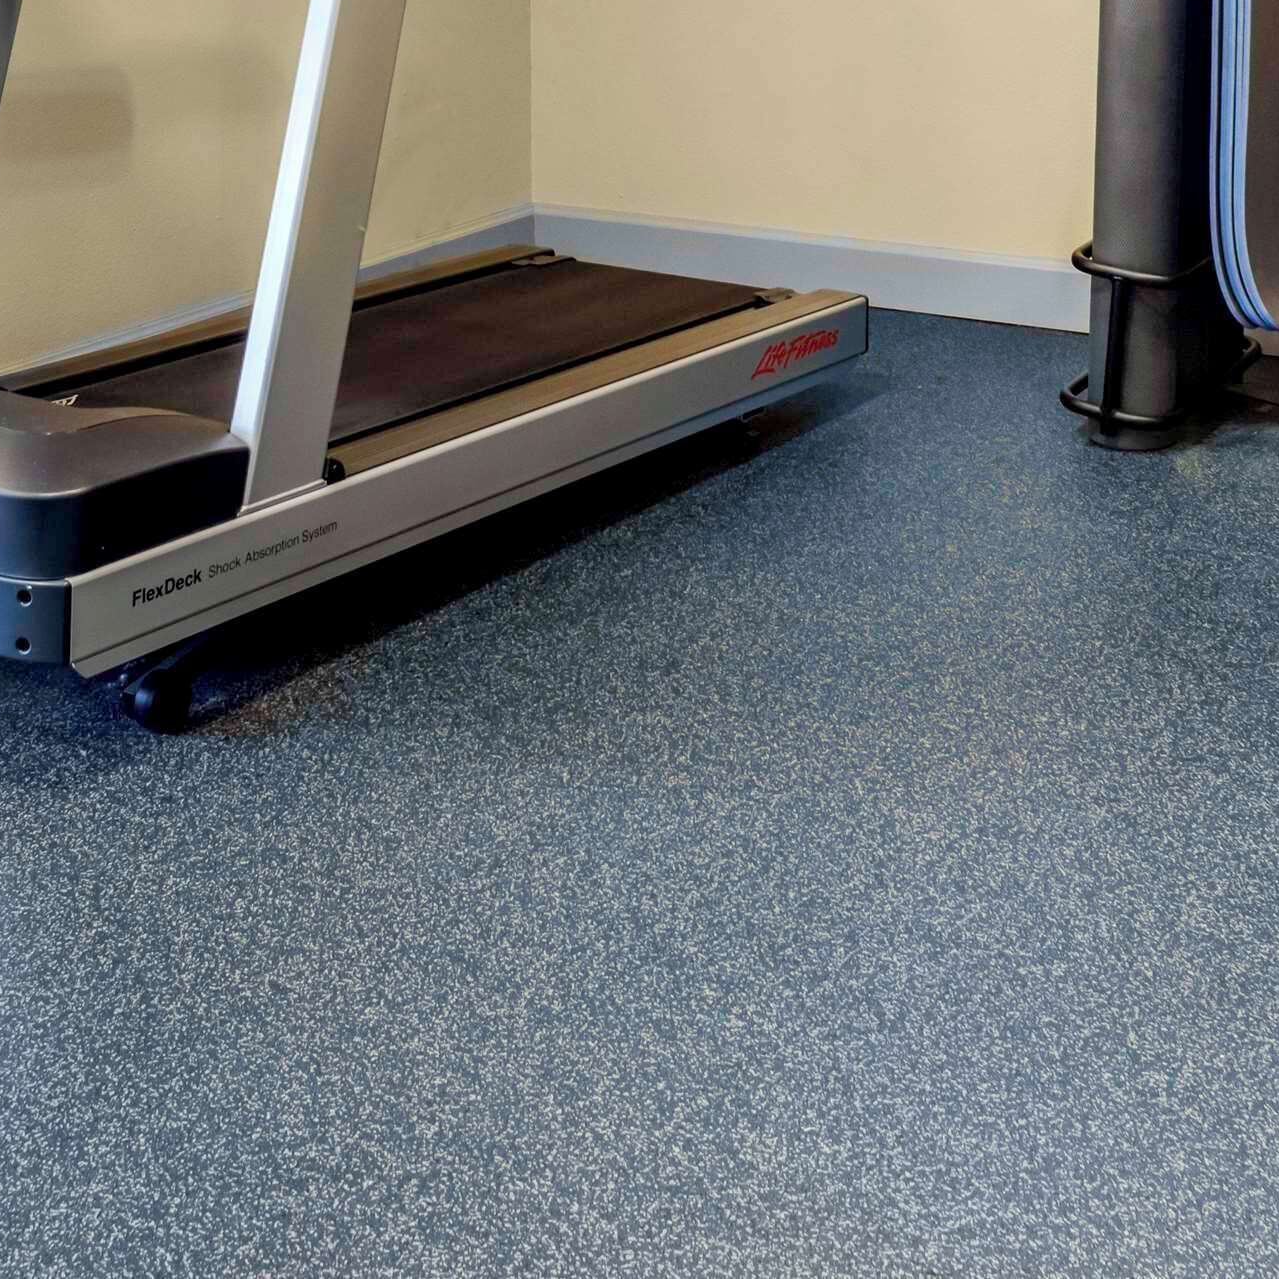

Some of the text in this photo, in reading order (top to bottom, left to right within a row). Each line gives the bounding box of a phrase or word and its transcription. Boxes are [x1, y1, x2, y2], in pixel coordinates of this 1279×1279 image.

[132, 520, 338, 607] FlexDeck Shock Absorption System
